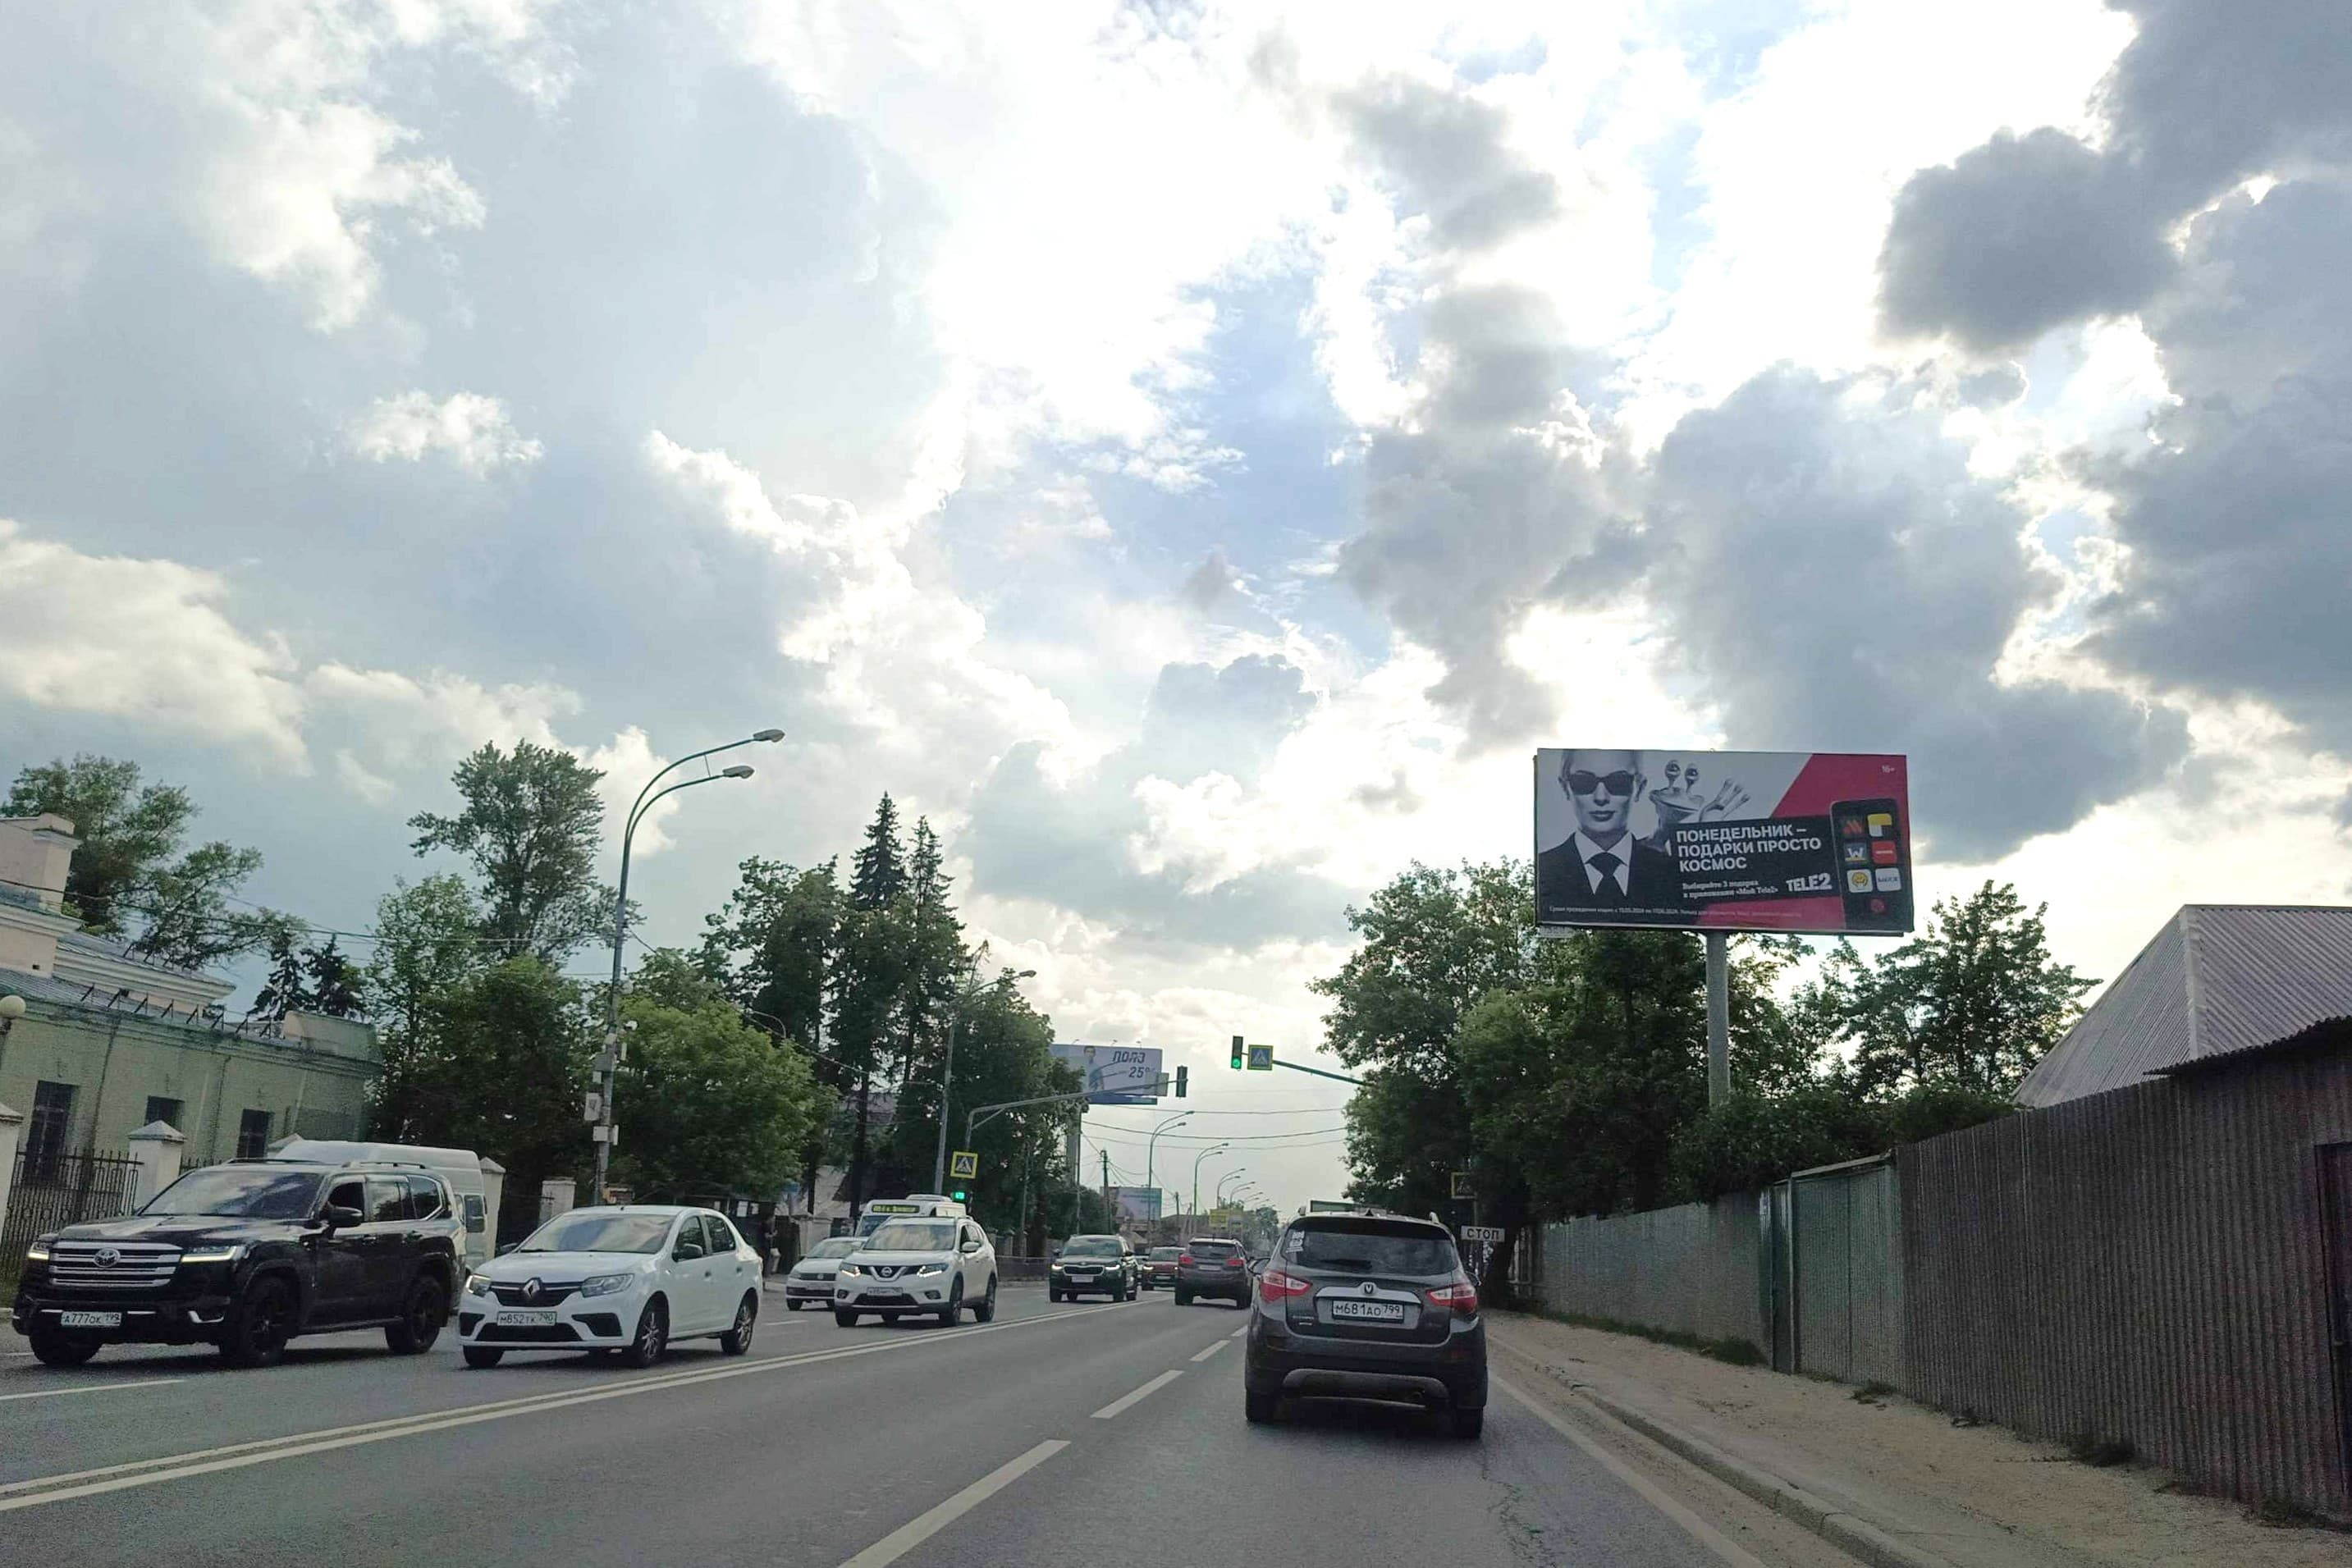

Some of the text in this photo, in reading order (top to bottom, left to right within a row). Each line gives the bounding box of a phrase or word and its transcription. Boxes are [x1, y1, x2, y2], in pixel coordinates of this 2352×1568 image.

[1676, 824, 1794, 843] ПОНЕДЕЛЬНИК
[1677, 837, 1822, 859] ПОДАРКИ ПРОСТО
[1679, 856, 1747, 872] КОСМОС
[1785, 872, 1833, 892] TELE2
[1467, 1227, 1499, 1240] СТОП
